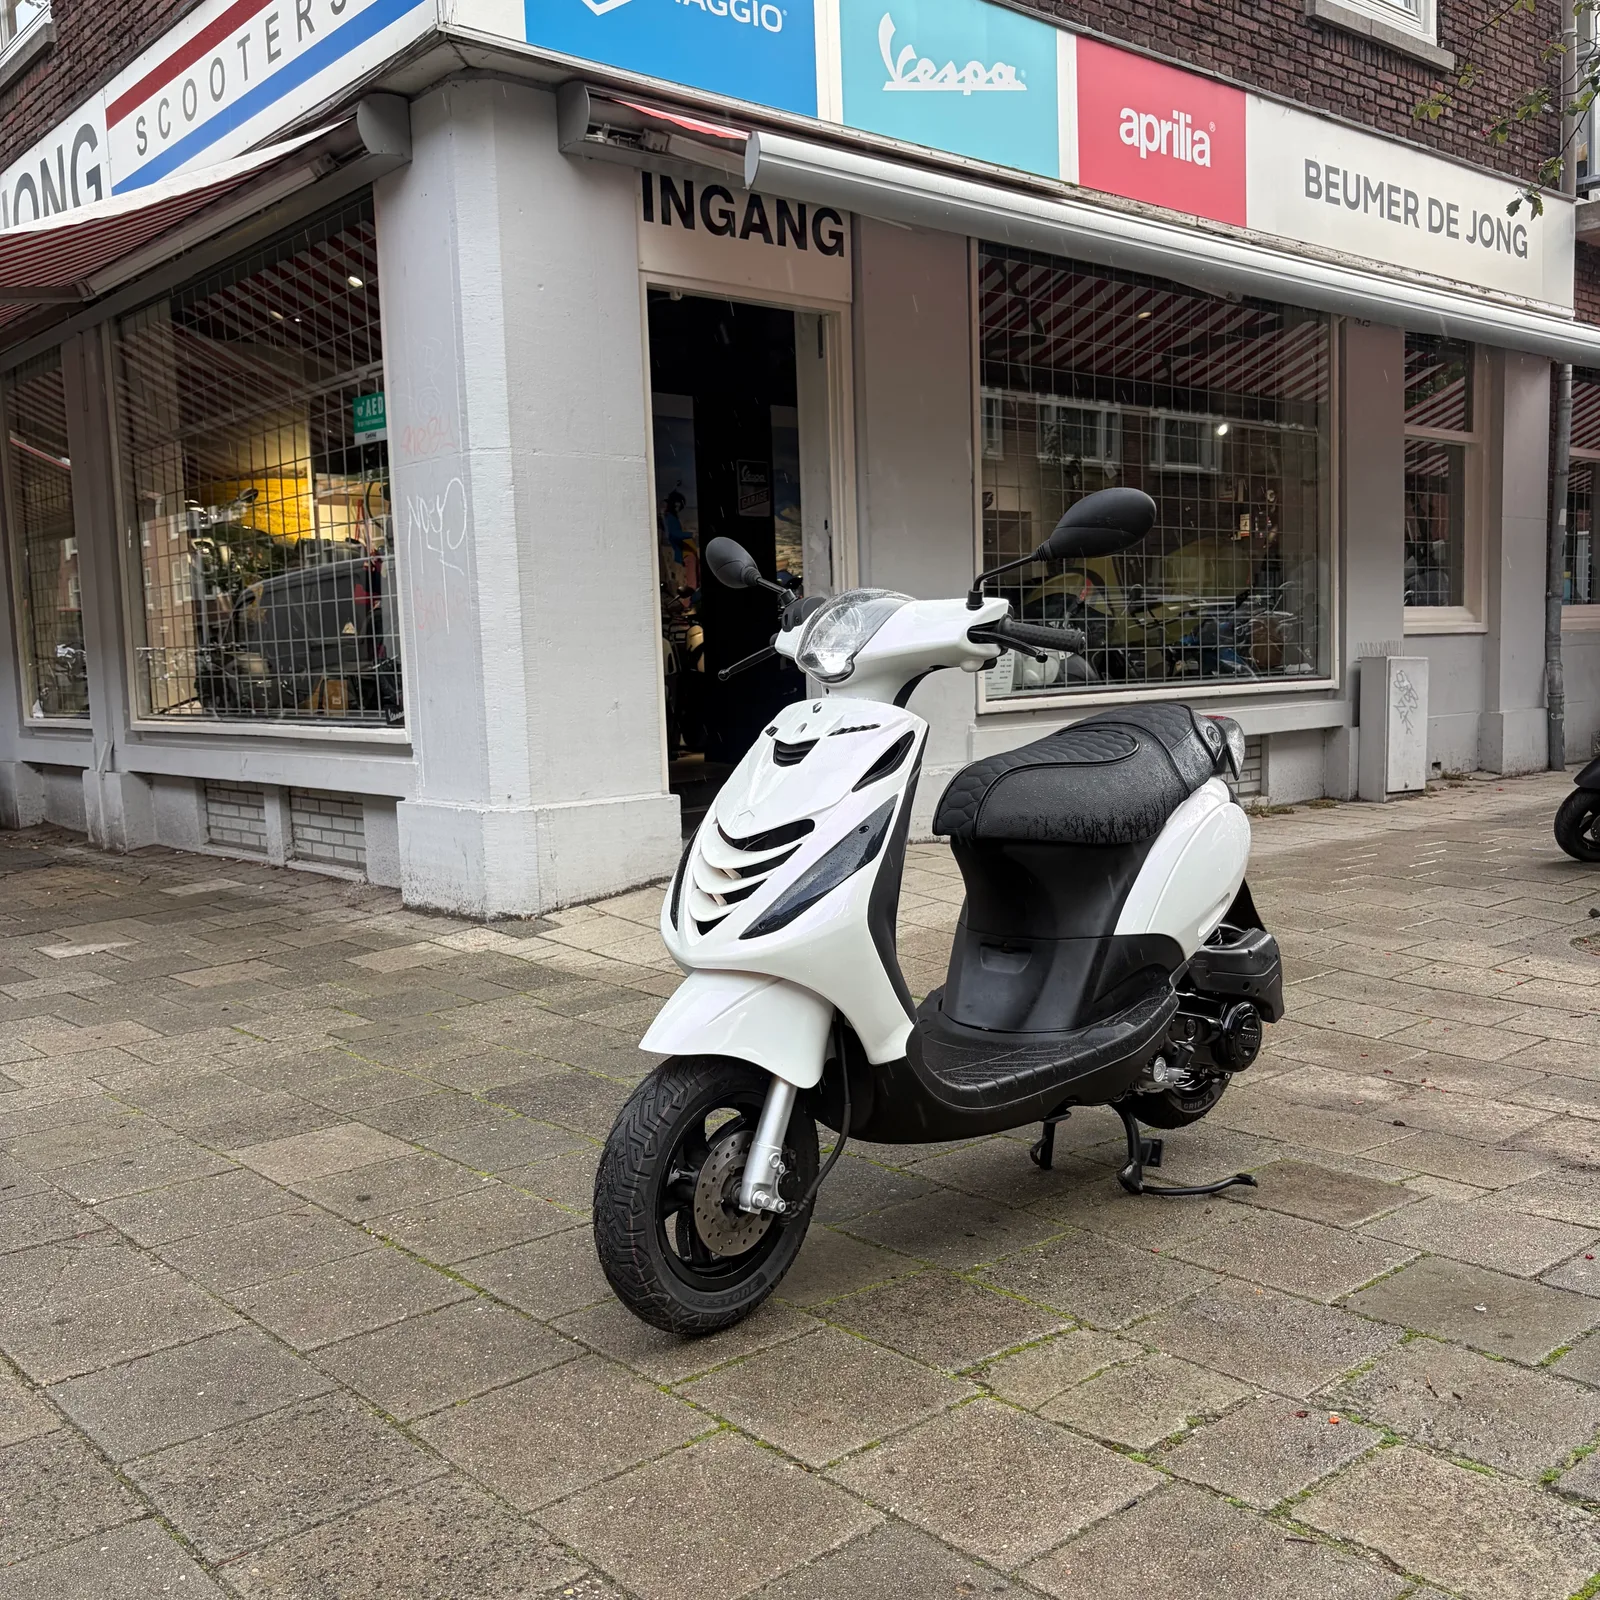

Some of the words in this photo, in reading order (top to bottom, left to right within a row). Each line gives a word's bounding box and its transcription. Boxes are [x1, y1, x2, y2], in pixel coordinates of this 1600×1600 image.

[675, 0, 782, 33] GGIO
[878, 12, 1028, 96] Vespa
[1119, 107, 1211, 168] aprilia
[641, 171, 846, 258] INGANG
[1304, 158, 1420, 229] BEUMER
[1428, 196, 1460, 240] DE
[1466, 210, 1529, 259] JONG
[366, 396, 384, 417] AED
[1183, 1100, 1203, 1110] GRIP
